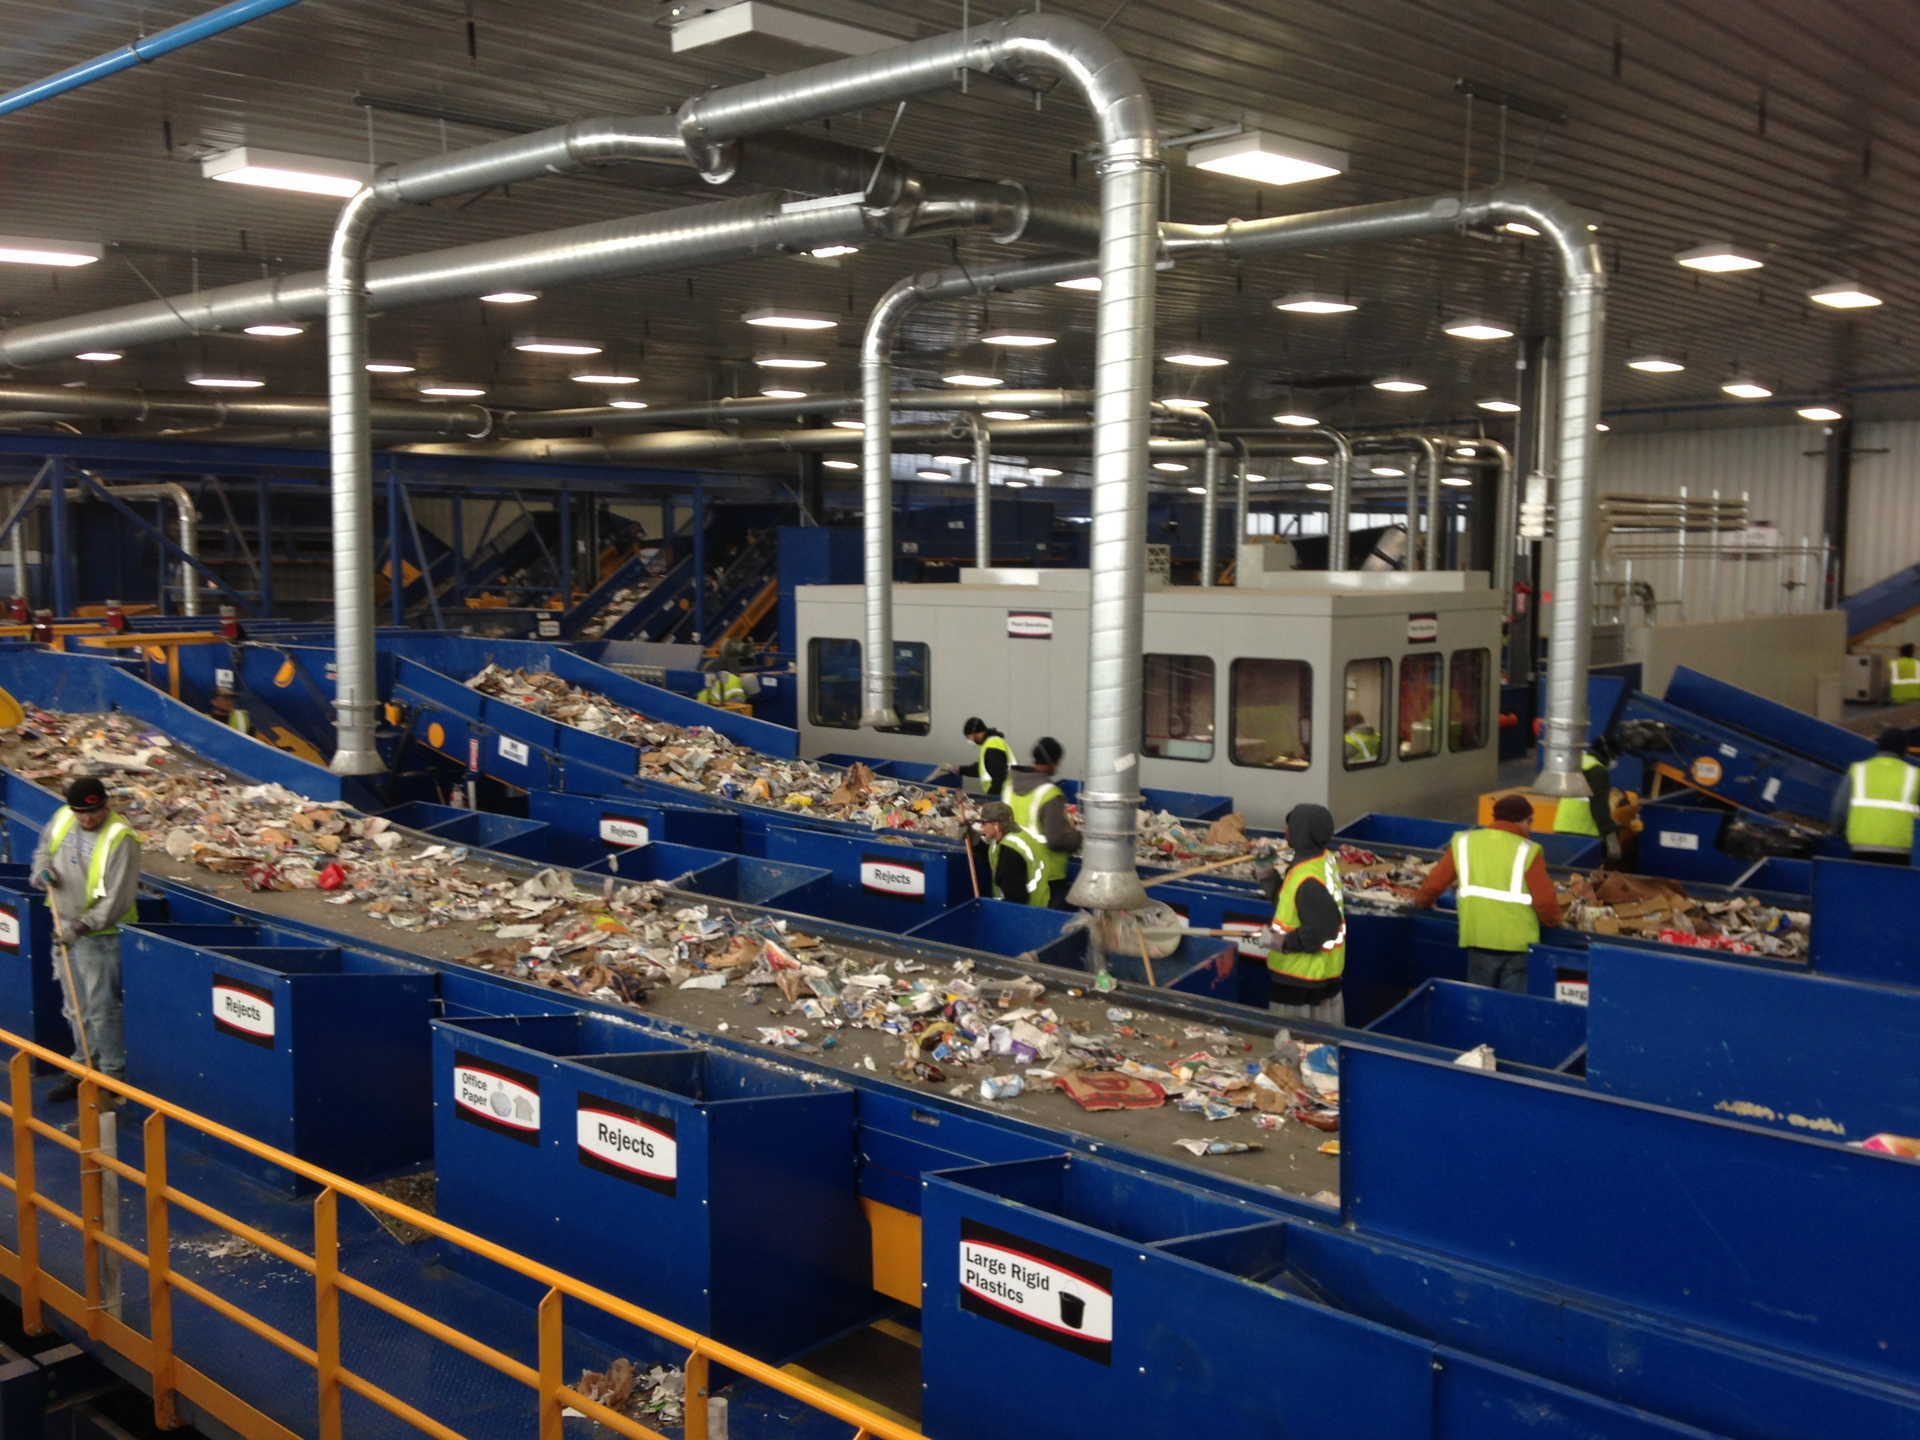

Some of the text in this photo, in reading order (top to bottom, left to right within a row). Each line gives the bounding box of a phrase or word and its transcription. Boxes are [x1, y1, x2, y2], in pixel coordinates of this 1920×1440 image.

[610, 824, 638, 839] Rejects
[874, 868, 911, 885] Rejects
[1561, 985, 1588, 1001] Larg
[225, 995, 262, 1021] Rejects
[462, 1072, 488, 1091] Office
[462, 1088, 488, 1107] Paper
[598, 1122, 655, 1158] Rejects
[966, 1247, 1050, 1291] Large Rigid
[966, 1269, 1024, 1304] Plastics
